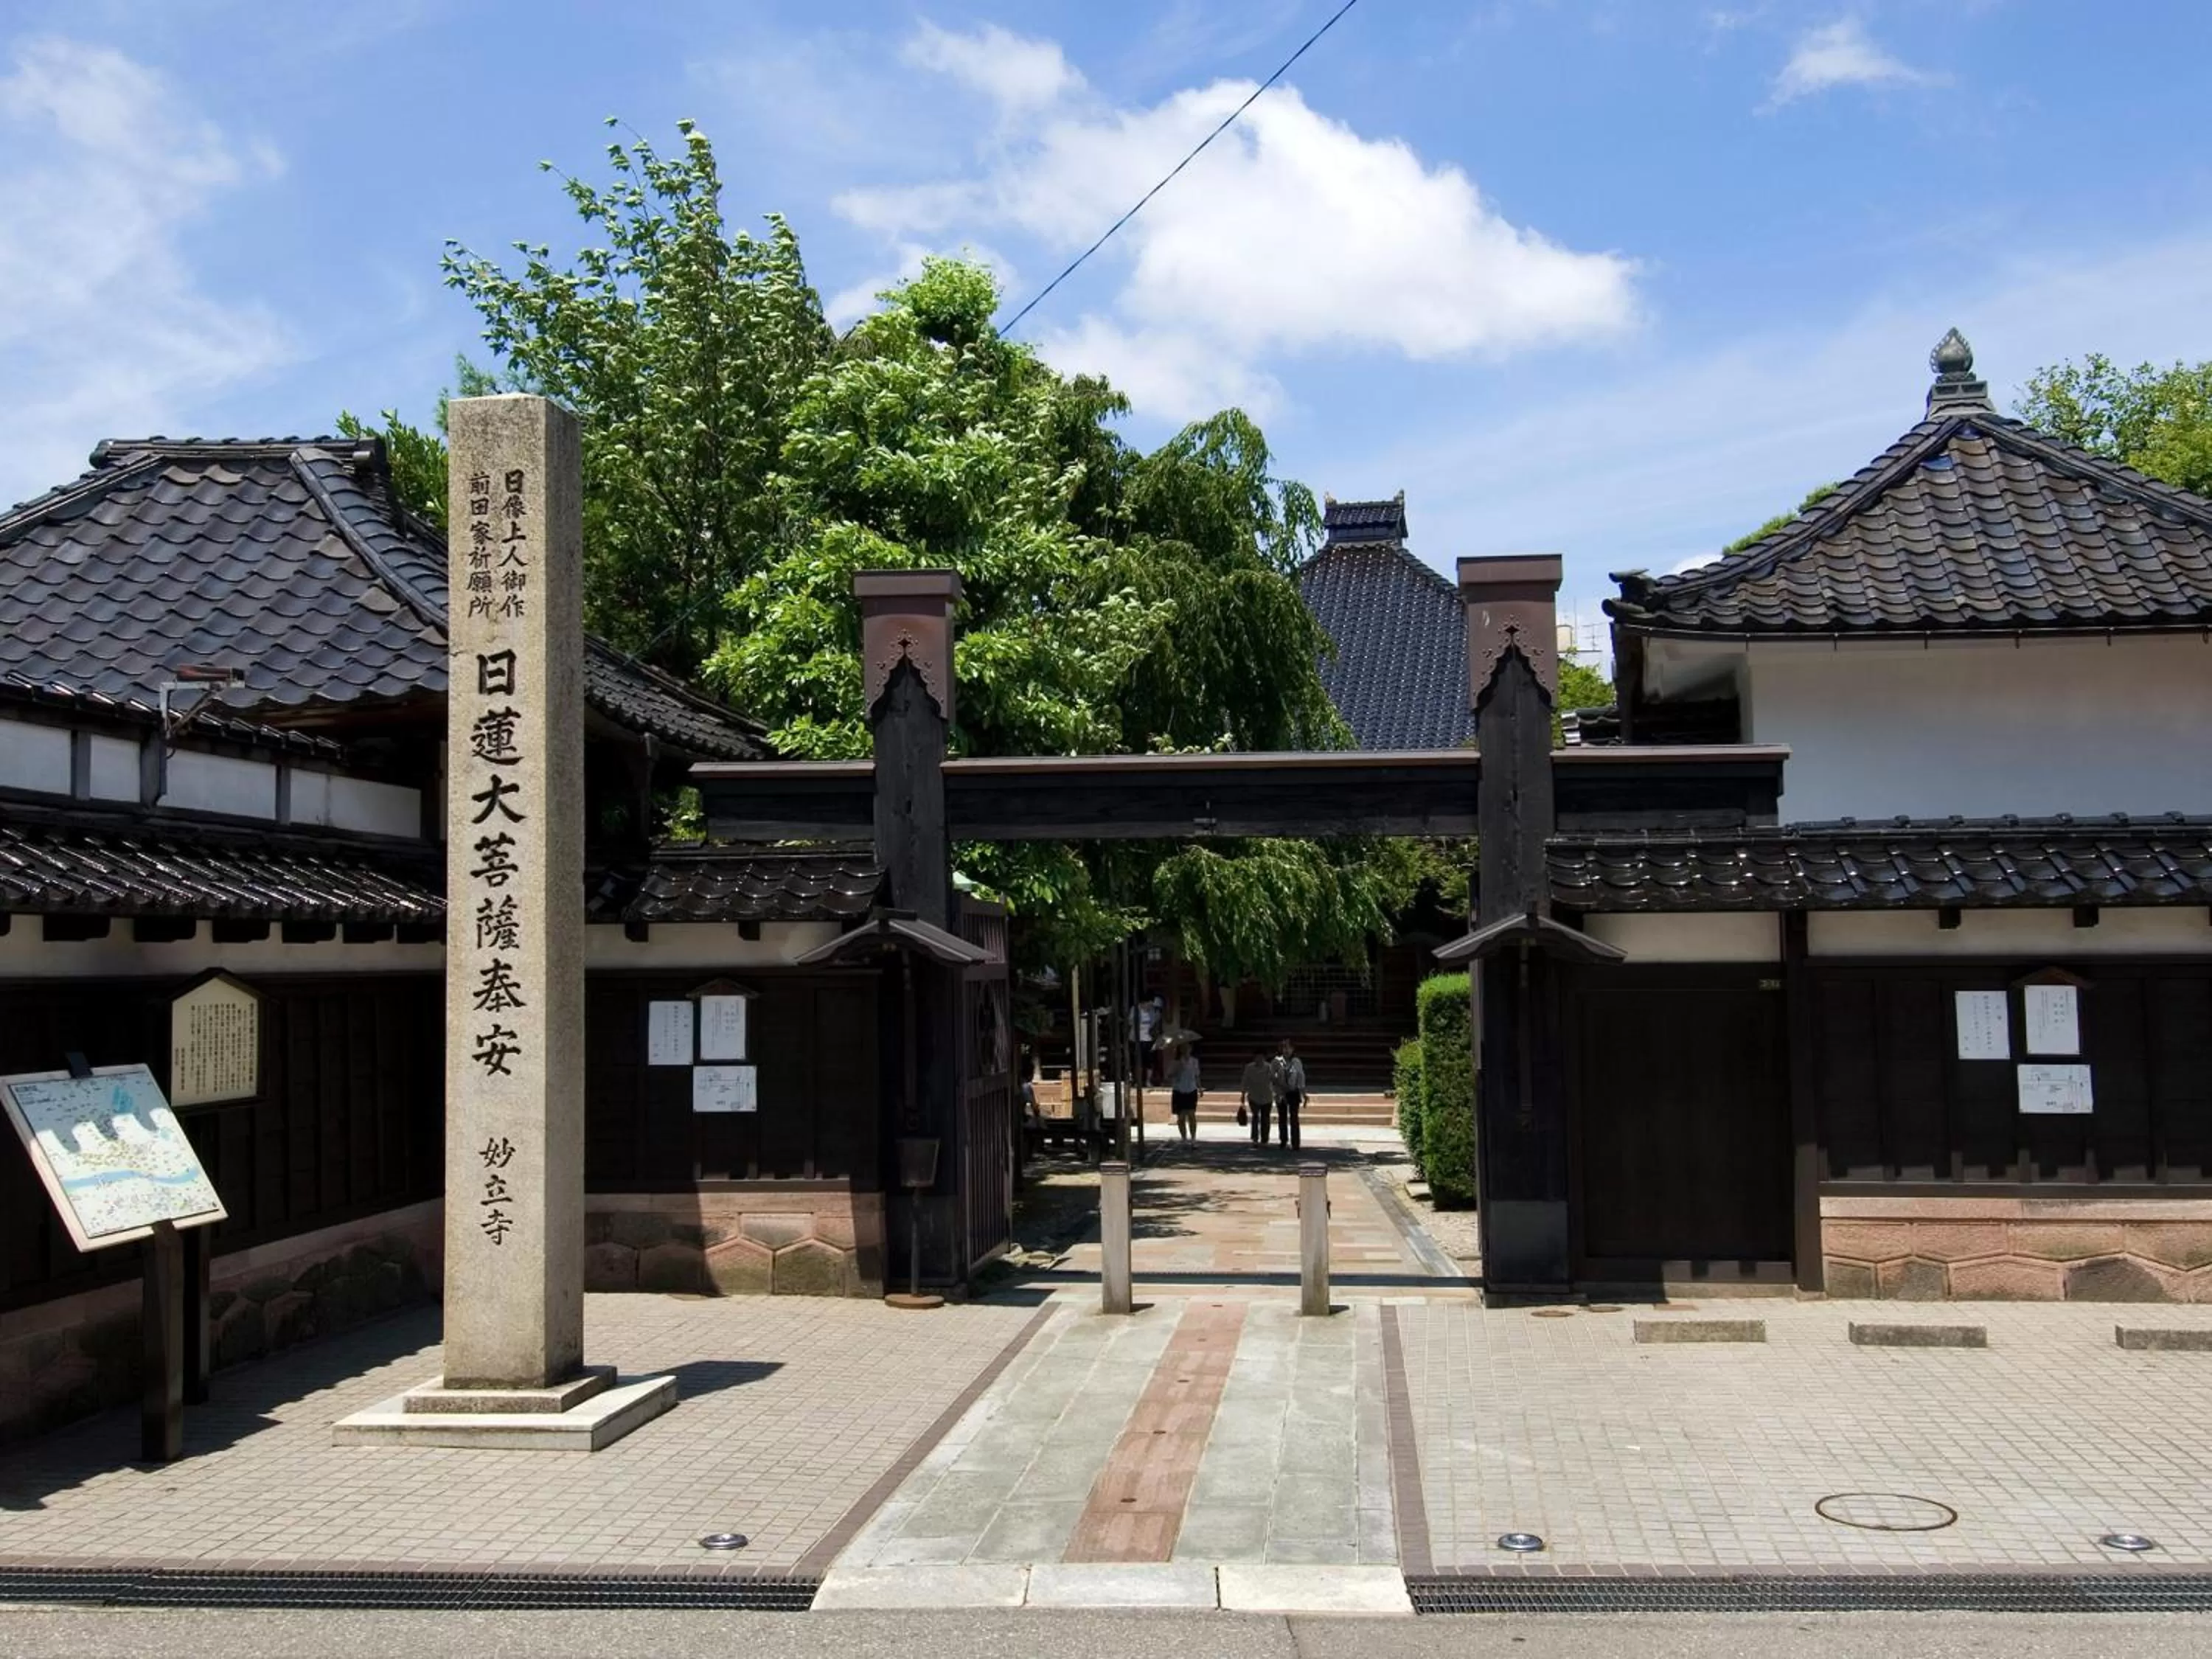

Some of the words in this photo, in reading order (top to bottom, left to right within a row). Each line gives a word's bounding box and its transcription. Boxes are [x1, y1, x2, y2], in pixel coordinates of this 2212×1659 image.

[467, 472, 493, 619] 前田家祈願所
[498, 469, 528, 618] 日像上人御作
[470, 648, 526, 1076] 日蓮大菩薩奉安
[479, 1137, 516, 1246] 妙立寺
